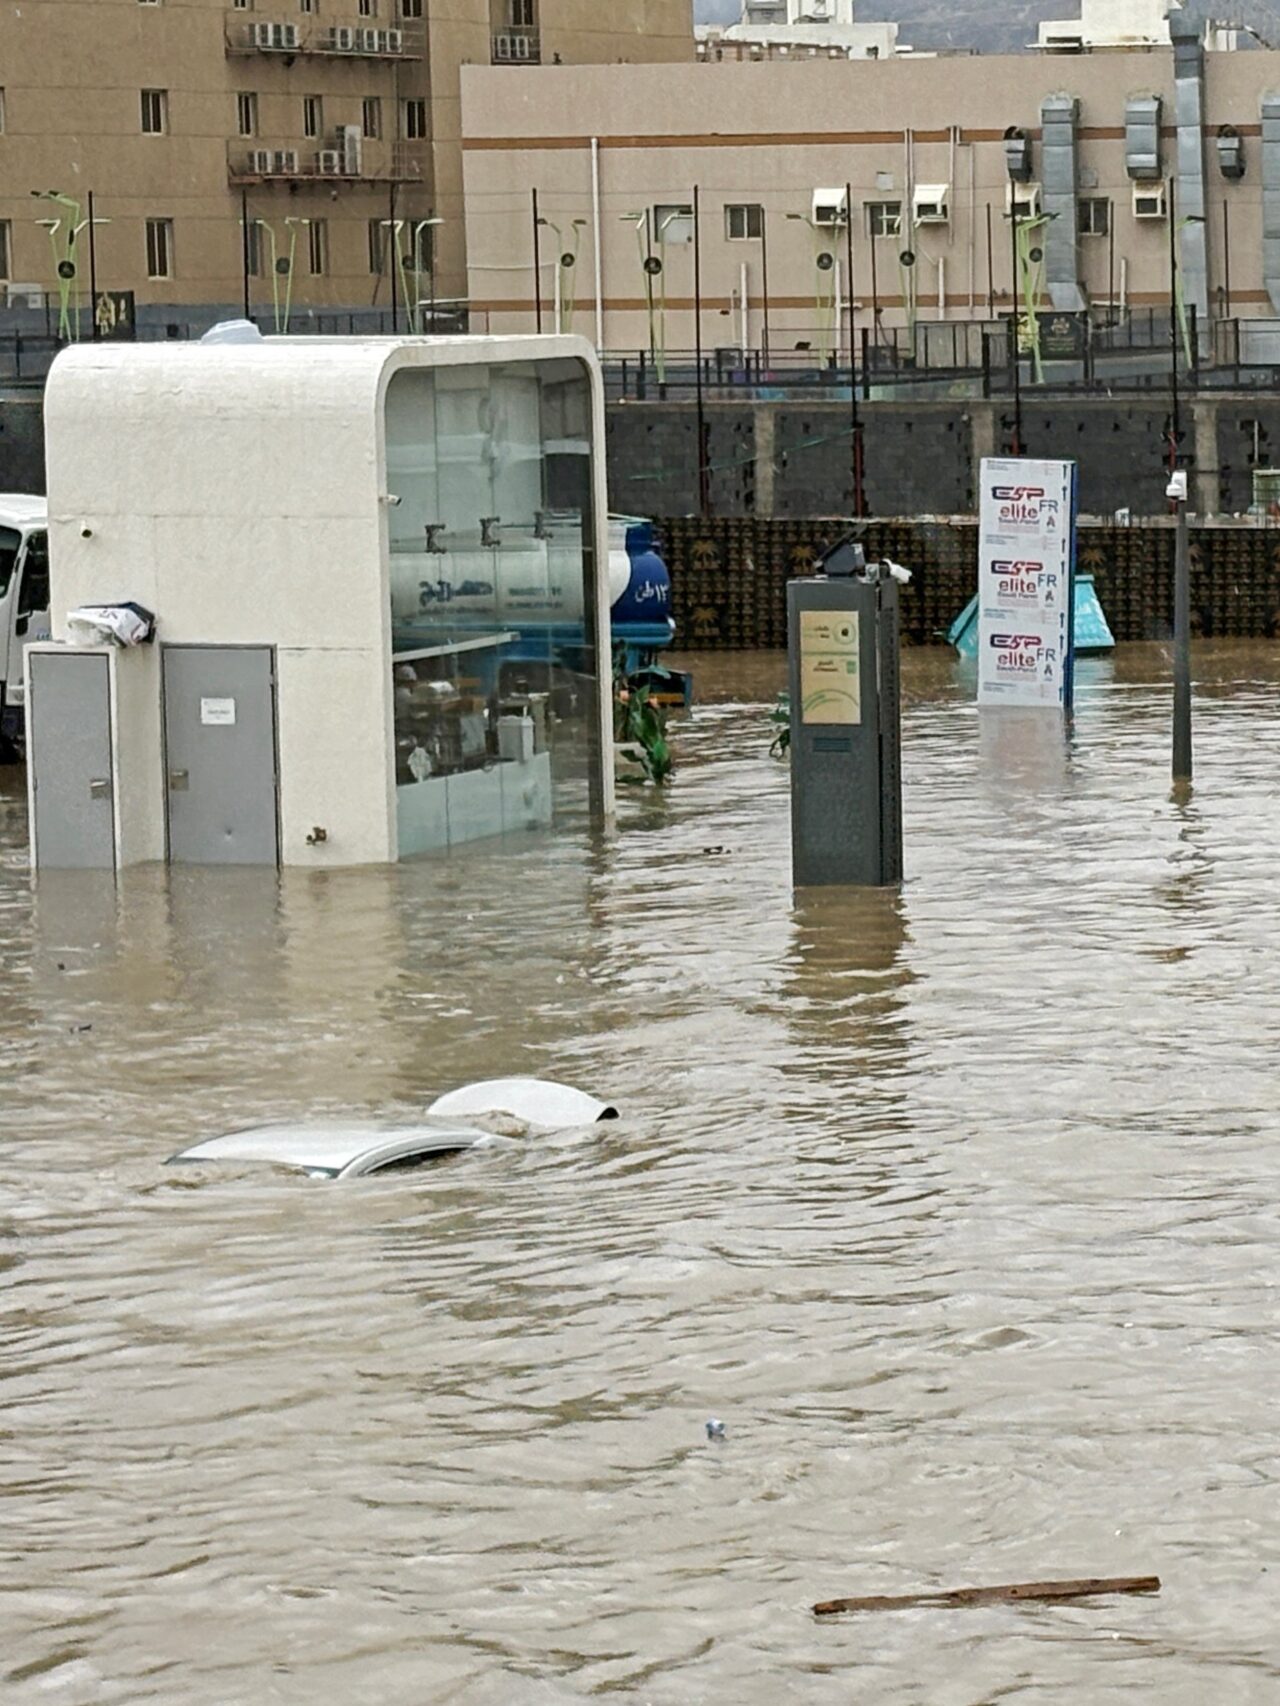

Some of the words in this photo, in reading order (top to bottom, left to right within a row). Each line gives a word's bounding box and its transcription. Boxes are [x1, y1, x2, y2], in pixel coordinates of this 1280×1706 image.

[1000, 503, 1038, 519] elite
[999, 578, 1036, 593] elite
[998, 651, 1035, 667] elite
